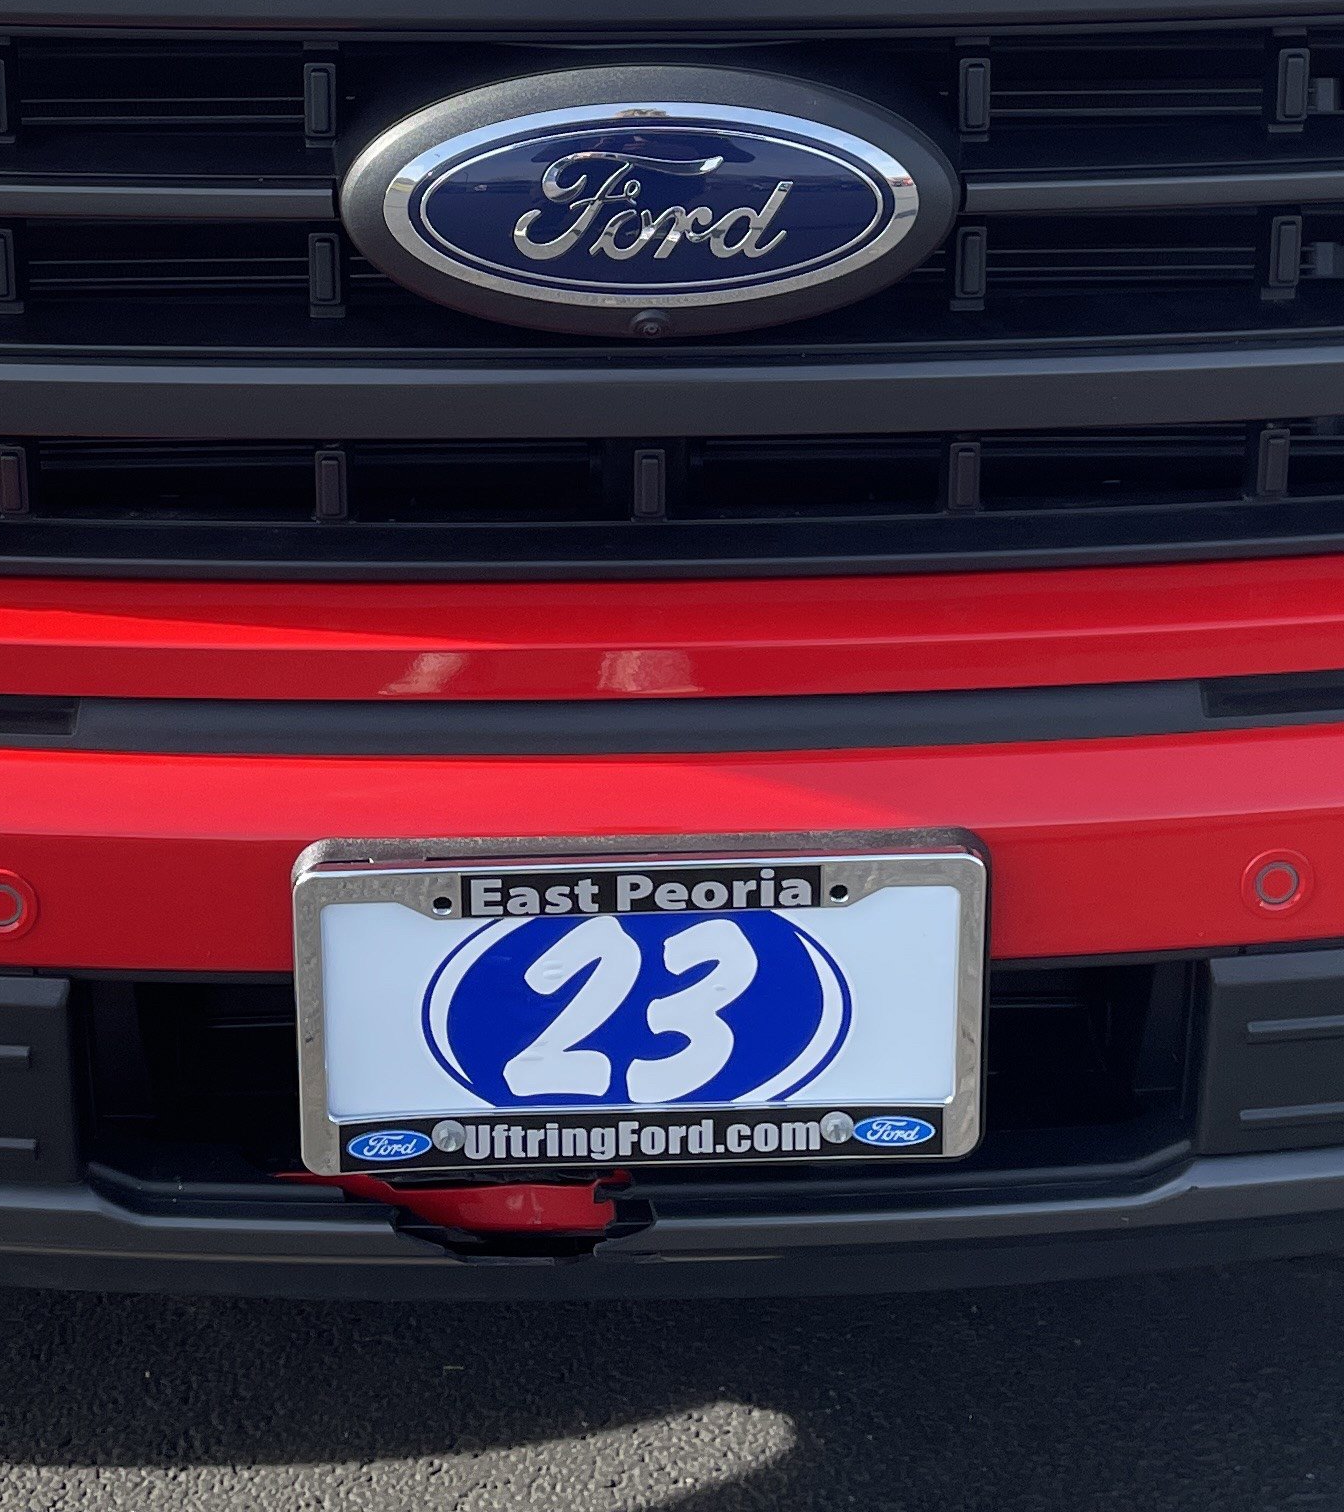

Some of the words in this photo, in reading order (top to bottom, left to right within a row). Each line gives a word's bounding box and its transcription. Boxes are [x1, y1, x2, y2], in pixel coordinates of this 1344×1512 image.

[513, 151, 794, 261] Ford
[470, 878, 600, 916] East
[616, 868, 812, 912] Peoria
[503, 915, 758, 1104] 23
[363, 1135, 417, 1156] Ford
[464, 1119, 821, 1160] UftringFord.com
[866, 1120, 920, 1140] Ford
